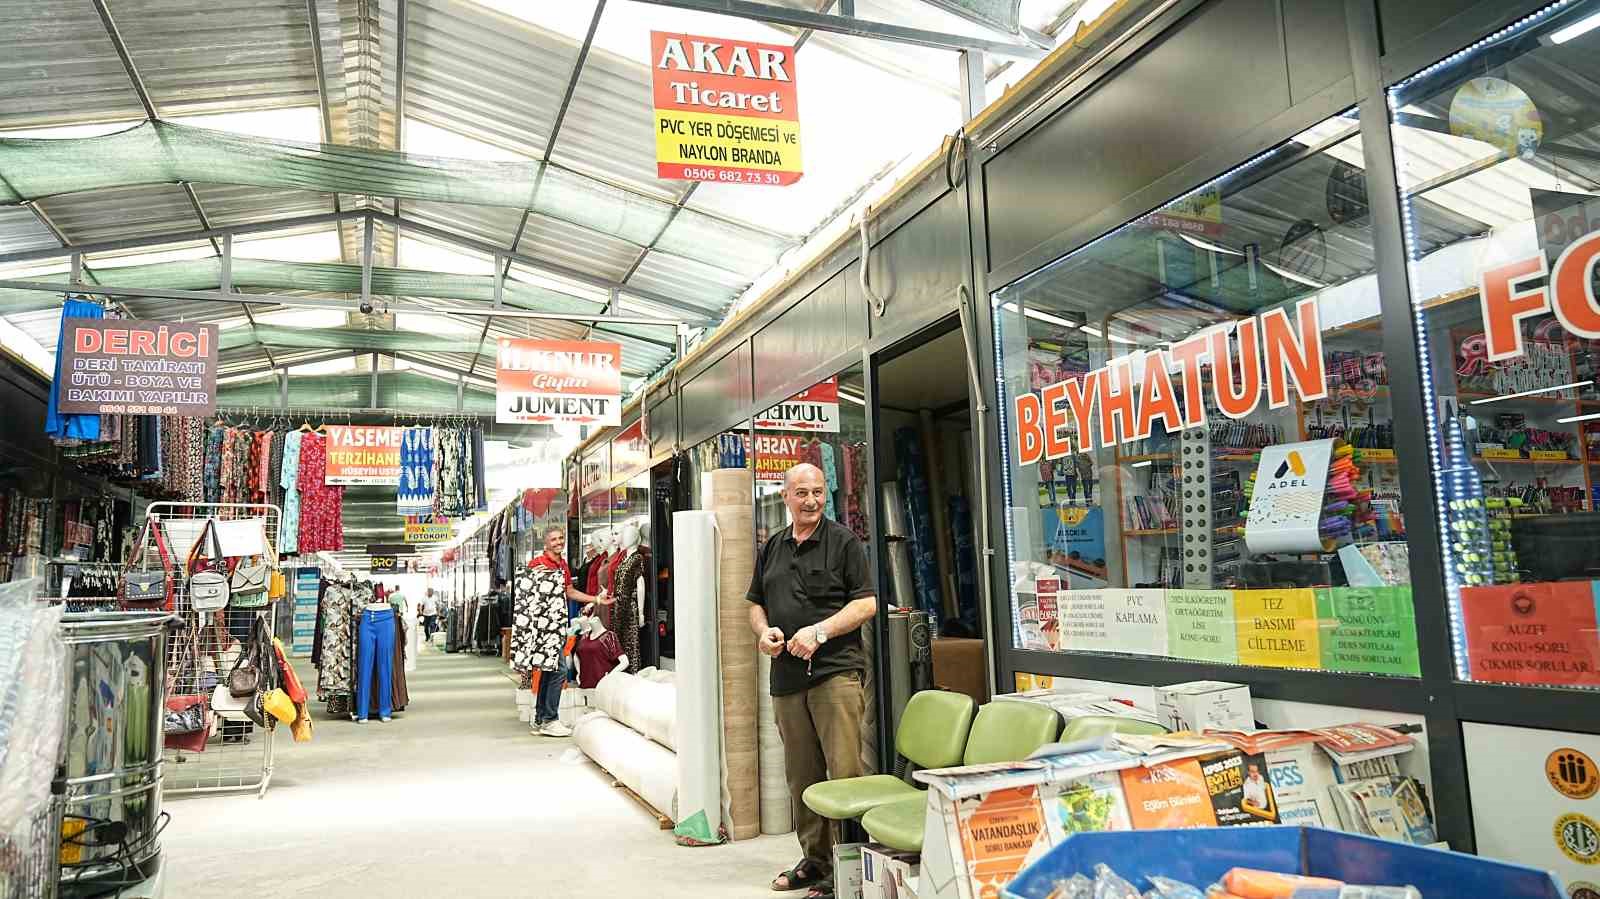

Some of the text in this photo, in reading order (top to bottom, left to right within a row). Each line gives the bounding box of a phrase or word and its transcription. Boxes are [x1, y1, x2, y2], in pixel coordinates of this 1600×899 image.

[657, 38, 792, 82] AKAR
[670, 81, 783, 113] Ticaret
[660, 118, 686, 135] PVC
[688, 121, 713, 138] YER
[717, 121, 780, 144] DÖŞEMESİ
[679, 143, 782, 166] NAYLON BRANDA
[684, 168, 716, 179] 0506
[719, 171, 742, 182] 682
[765, 173, 780, 184] 30
[74, 325, 209, 358] DERİCİ
[73, 357, 118, 372] DERİ
[71, 371, 111, 386] ÜTÜ
[126, 375, 174, 389] BOYA
[177, 376, 202, 389] VE
[1015, 296, 1328, 466] BEYHATUN
[68, 389, 209, 404] BAKIMI YAPILIR
[509, 396, 609, 416] JUMENT
[1268, 479, 1309, 489] ADEL
[1126, 594, 1144, 607] PVC
[1261, 597, 1284, 610] TEZ
[1114, 612, 1159, 625] KAPLAMA
[1254, 617, 1297, 631] BASIMI
[1269, 765, 1304, 788] KPSS
[970, 822, 1040, 842] VATANDAŞLIK
